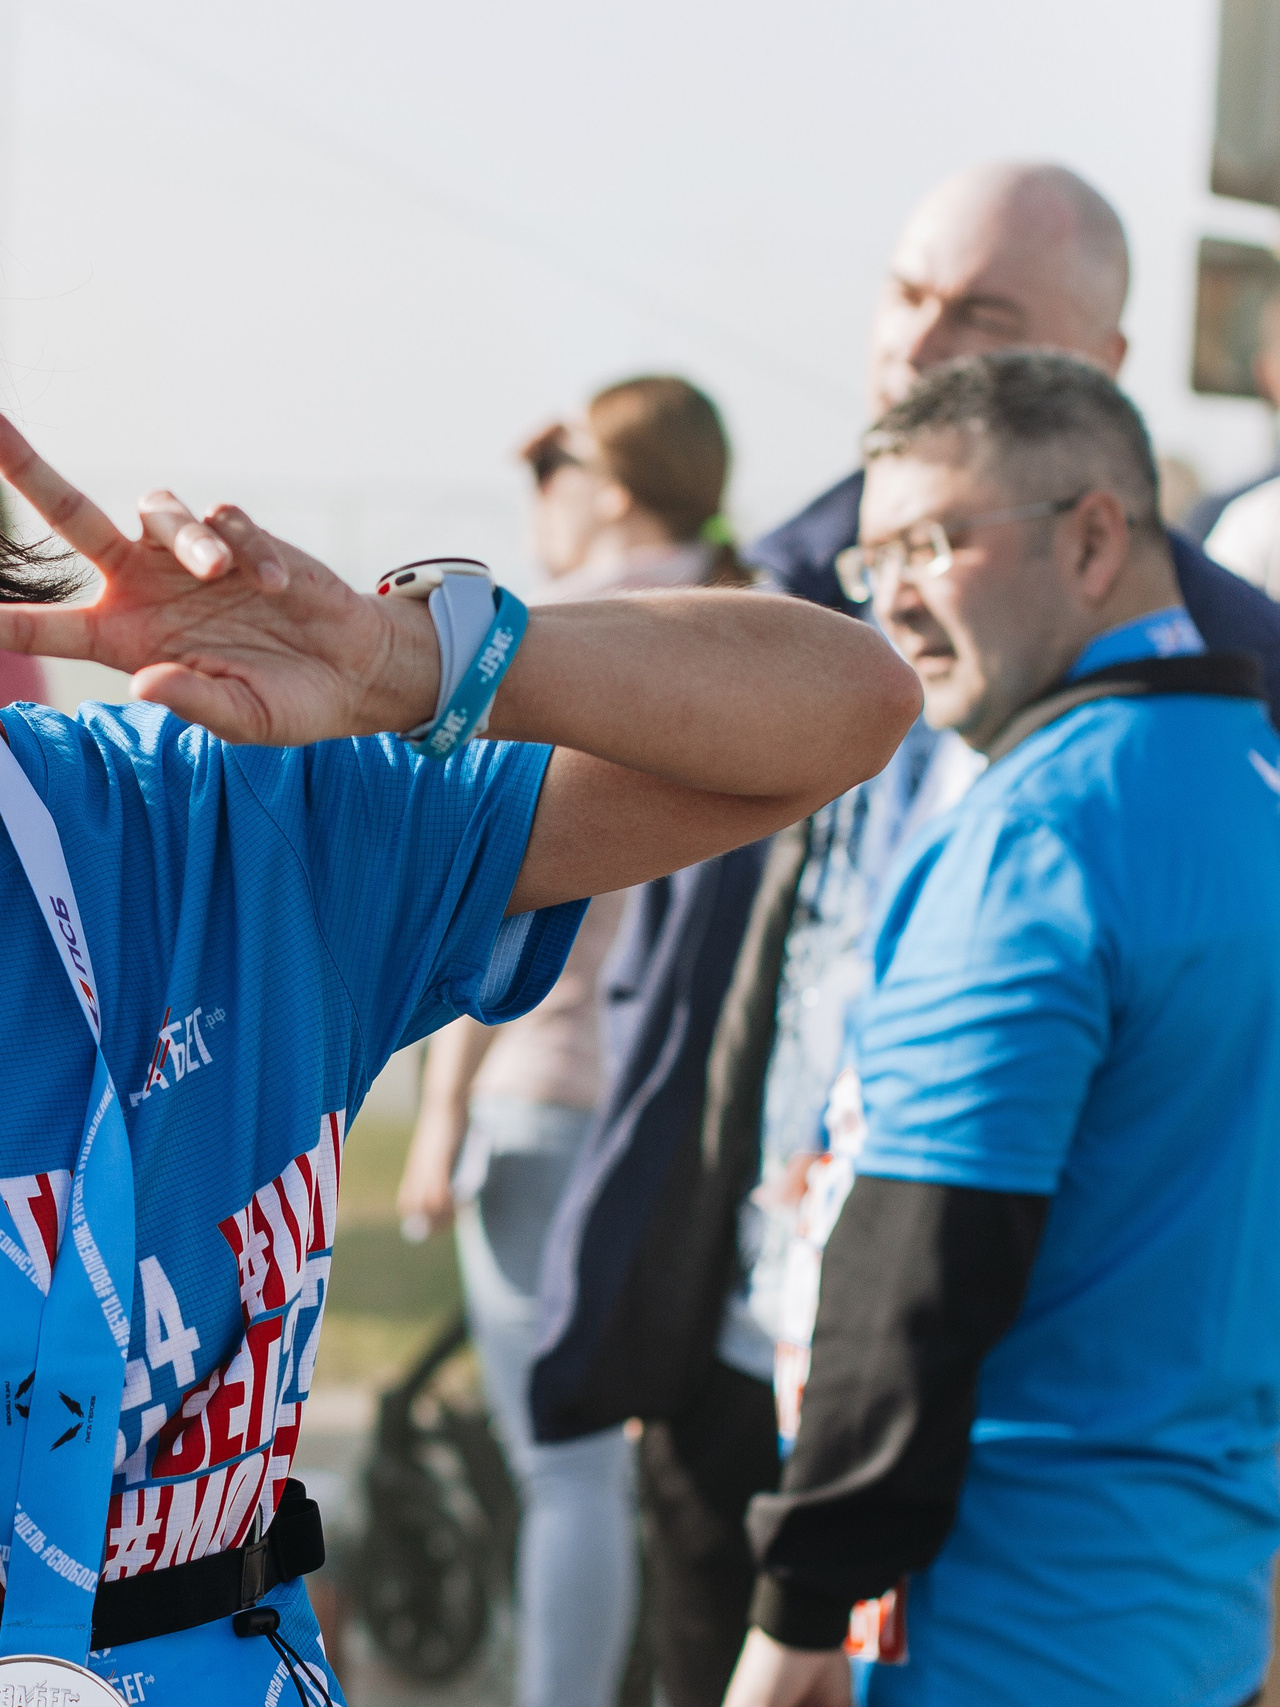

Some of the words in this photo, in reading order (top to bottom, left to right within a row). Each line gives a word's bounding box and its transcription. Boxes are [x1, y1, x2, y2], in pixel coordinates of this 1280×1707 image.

[49, 896, 87, 976] ПСБ
[72, 1221, 116, 1299] #ВОЛНЕНИЕ
[40, 1543, 99, 1594] #СВОБОД
